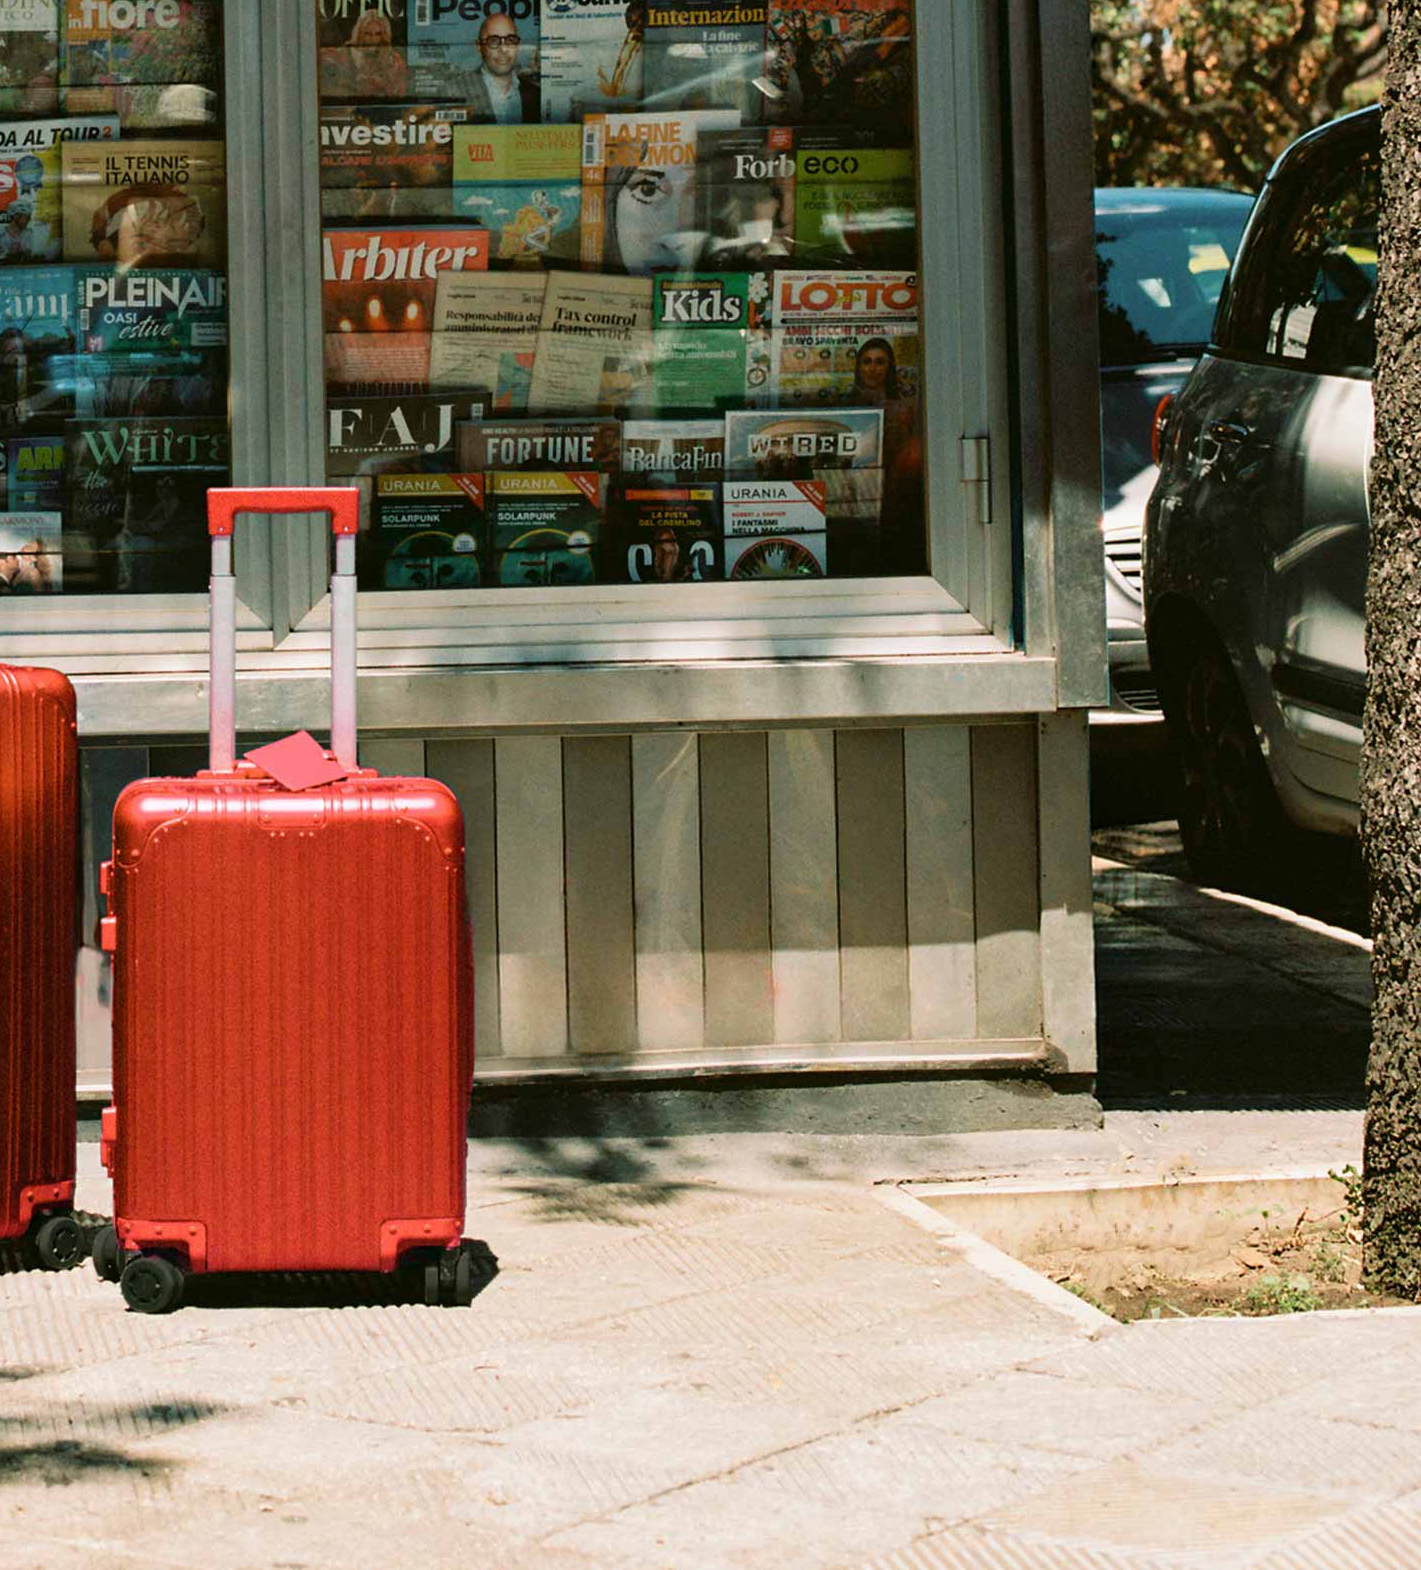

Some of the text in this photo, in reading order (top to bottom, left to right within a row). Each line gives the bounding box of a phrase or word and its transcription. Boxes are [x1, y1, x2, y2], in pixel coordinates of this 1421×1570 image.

[22, 129, 48, 147] AL
[105, 154, 190, 171] IL TENNIS
[780, 282, 917, 312] LOTTO
[660, 288, 742, 323] Kids
[103, 311, 138, 326] OASI
[554, 306, 587, 324] Tax
[485, 435, 596, 466] FORTUNE
[383, 479, 442, 493] URANIA
[499, 478, 558, 490] URANIA
[731, 487, 788, 500] URANIA
[380, 512, 441, 524] SOLARPUNK
[497, 511, 557, 522] SOLARPUNK
